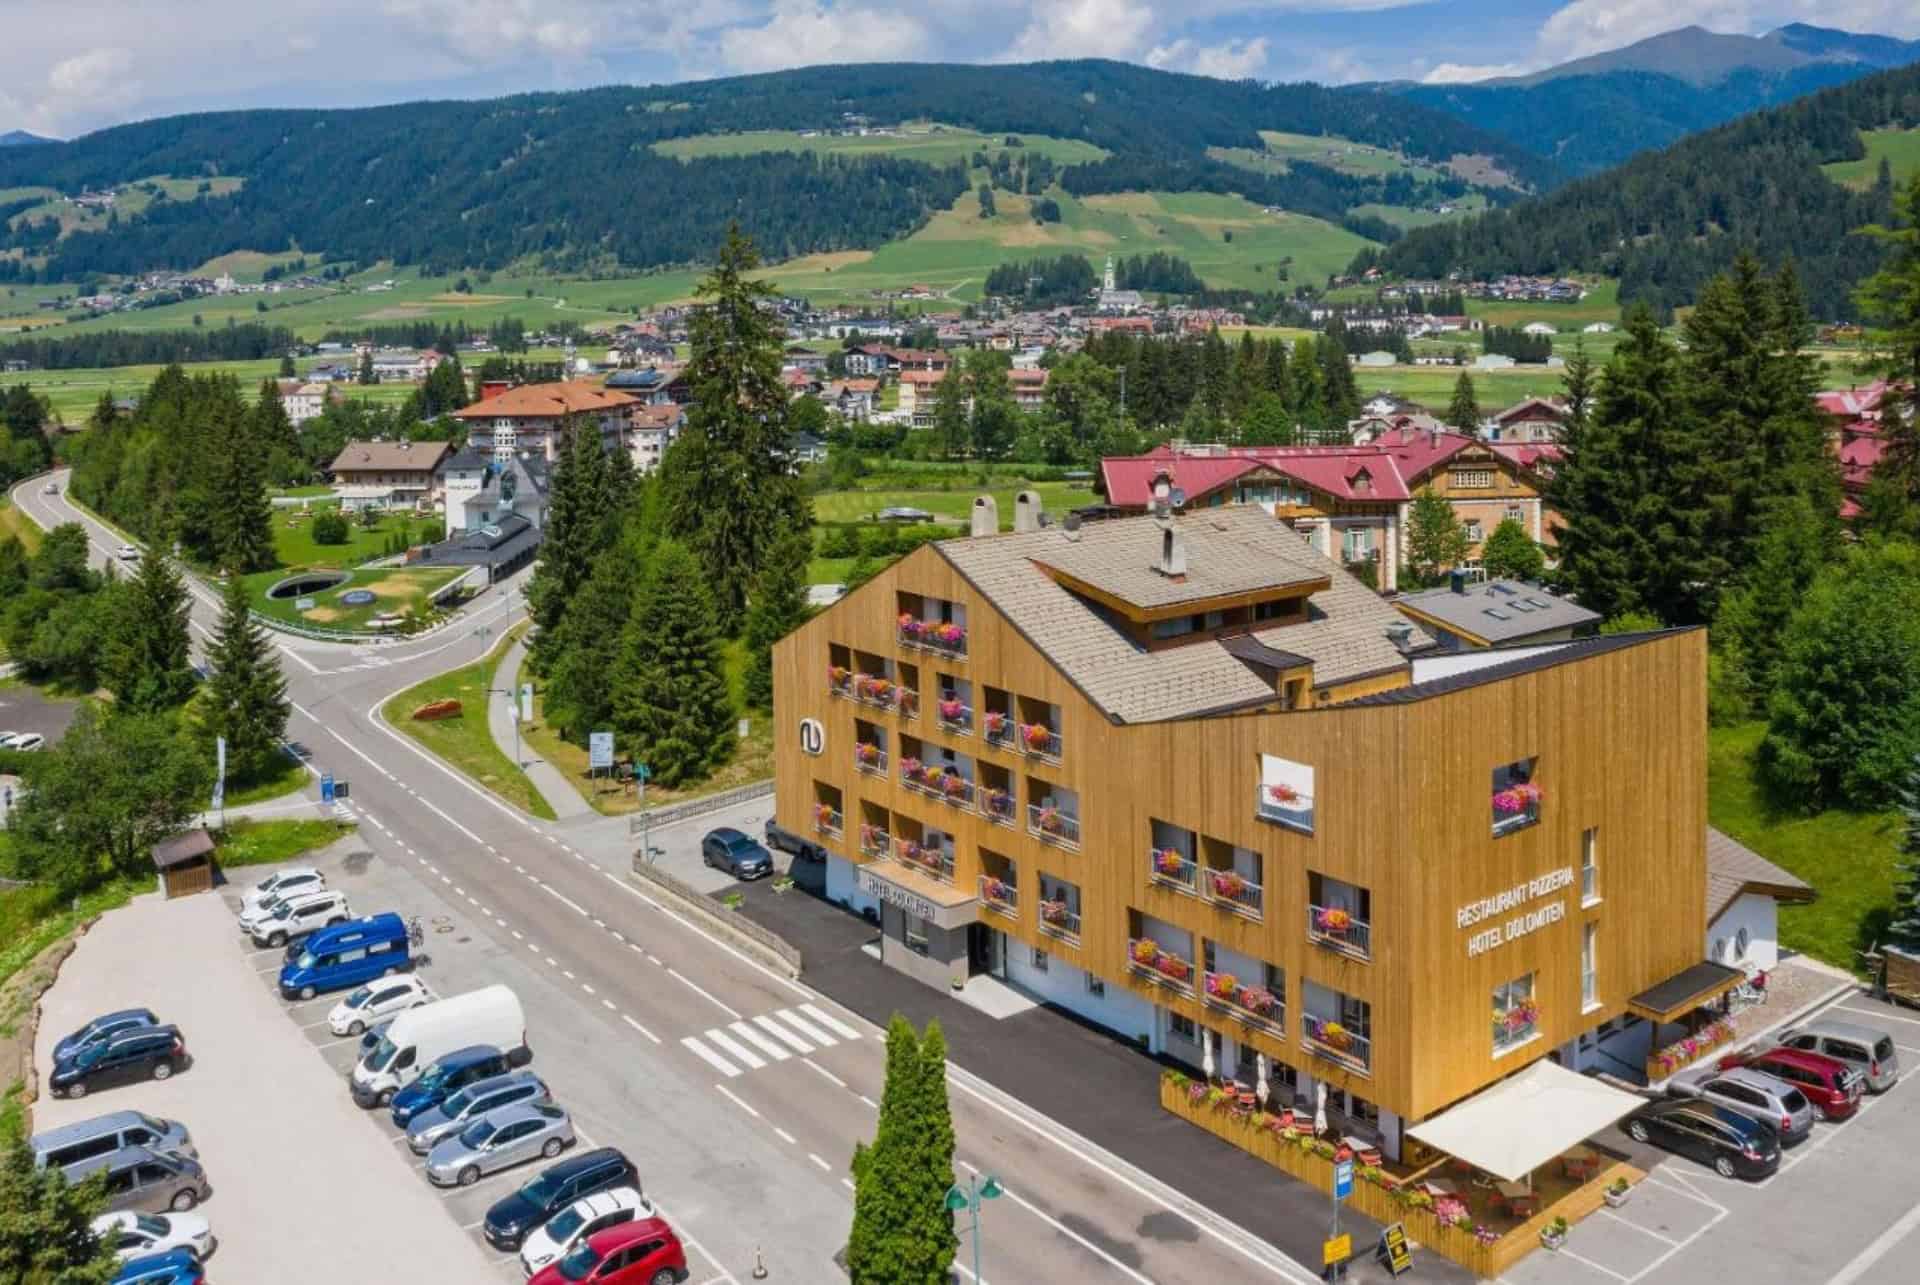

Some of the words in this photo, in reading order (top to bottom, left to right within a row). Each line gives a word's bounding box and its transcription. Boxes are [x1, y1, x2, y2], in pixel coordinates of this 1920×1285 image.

[1457, 883, 1528, 928] RESTAURANT
[1528, 865, 1574, 900] PIZZERIA
[1468, 927, 1504, 958] HOTEL
[1505, 900, 1565, 941] DOLOMITEN
